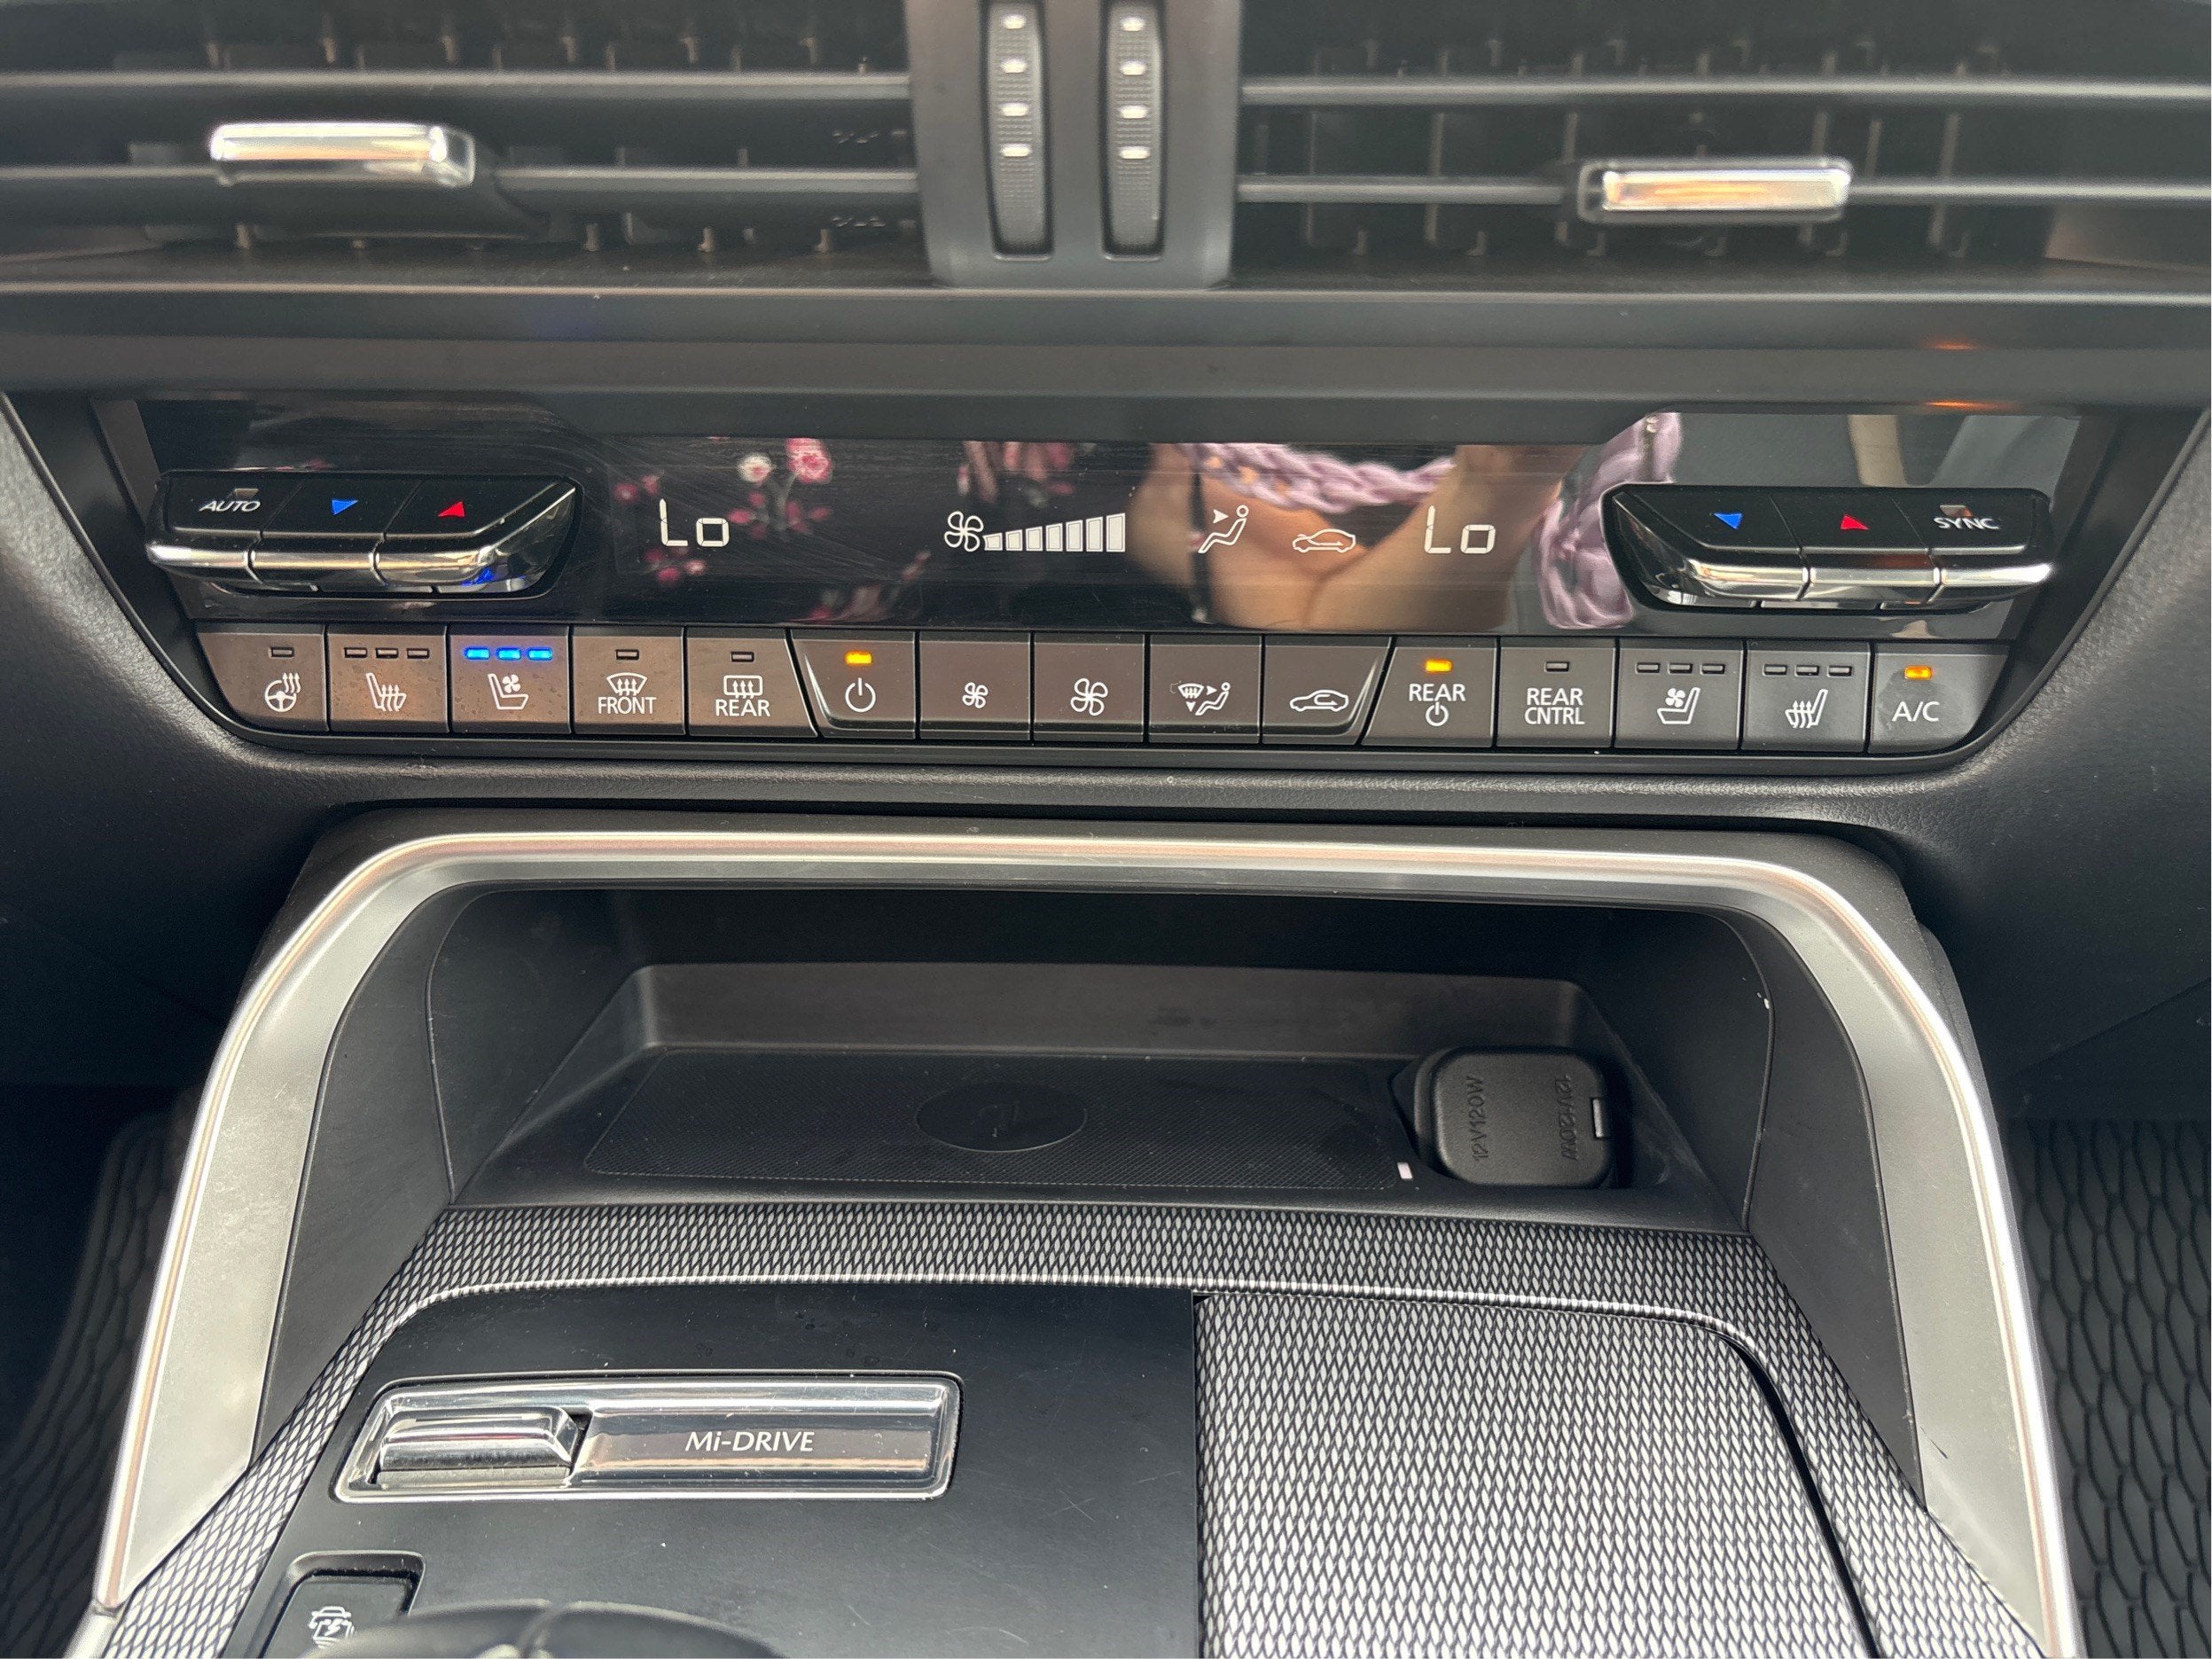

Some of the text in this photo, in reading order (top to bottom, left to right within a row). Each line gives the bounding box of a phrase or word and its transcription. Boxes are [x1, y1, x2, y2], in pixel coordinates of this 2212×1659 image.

[197, 498, 261, 513] AUTO
[659, 498, 730, 547] Lo
[1424, 505, 1496, 554] Lo
[1933, 515, 2000, 531] SYNC
[1408, 683, 1466, 703] REAR
[1525, 686, 1584, 707] REAR
[597, 694, 655, 715] FRONT
[714, 698, 771, 717] REAR
[1891, 700, 1941, 724] A/C
[1523, 706, 1585, 726] CNTRL
[684, 1428, 817, 1452] Mi-DRIVE
